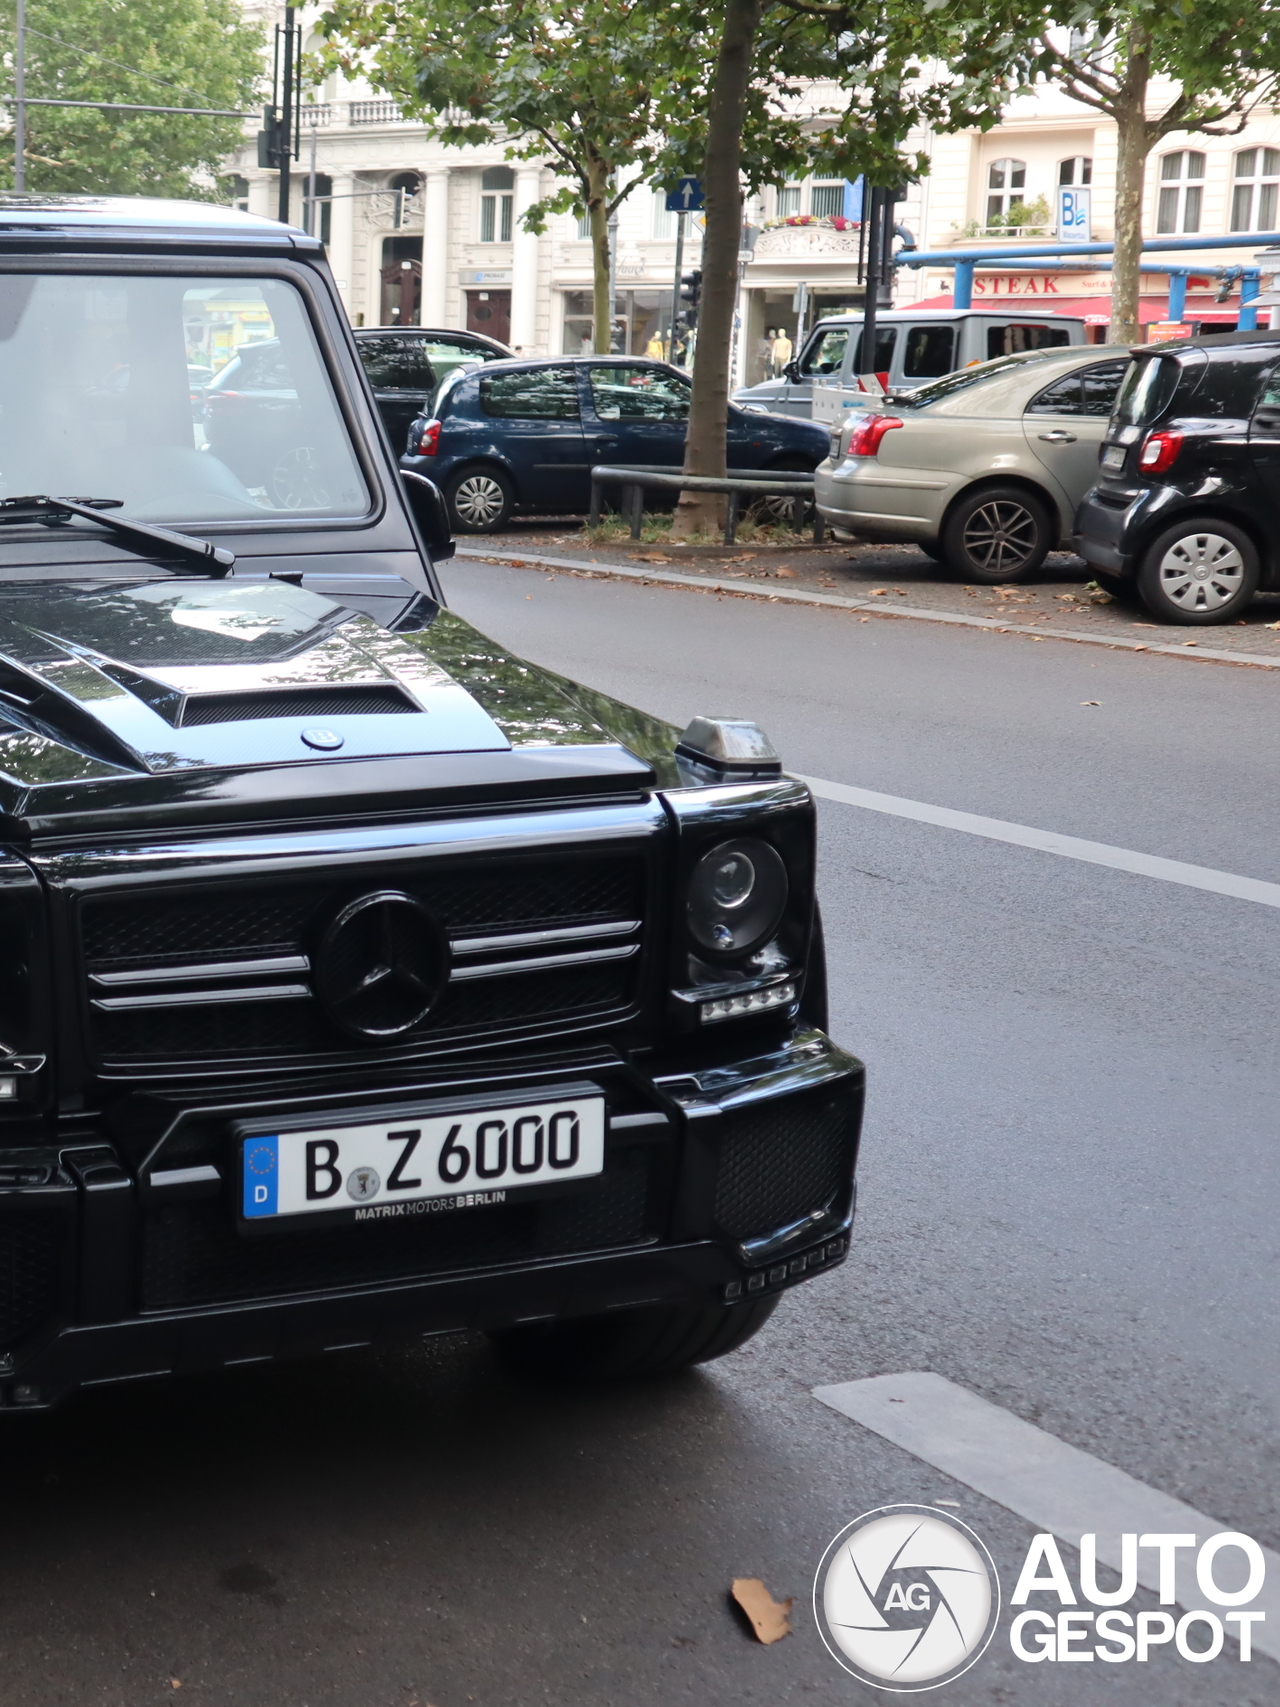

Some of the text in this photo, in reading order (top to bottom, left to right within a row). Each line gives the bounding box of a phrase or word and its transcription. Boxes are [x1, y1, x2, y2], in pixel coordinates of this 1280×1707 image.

[974, 276, 1060, 295] STEAK
[1081, 280, 1099, 288] Surf
[306, 1139, 342, 1201] B
[387, 1130, 421, 1191] Z
[438, 1110, 580, 1184] 6000
[254, 1186, 268, 1204] D
[355, 1190, 506, 1221] MATRIX MOTORS BERLIN
